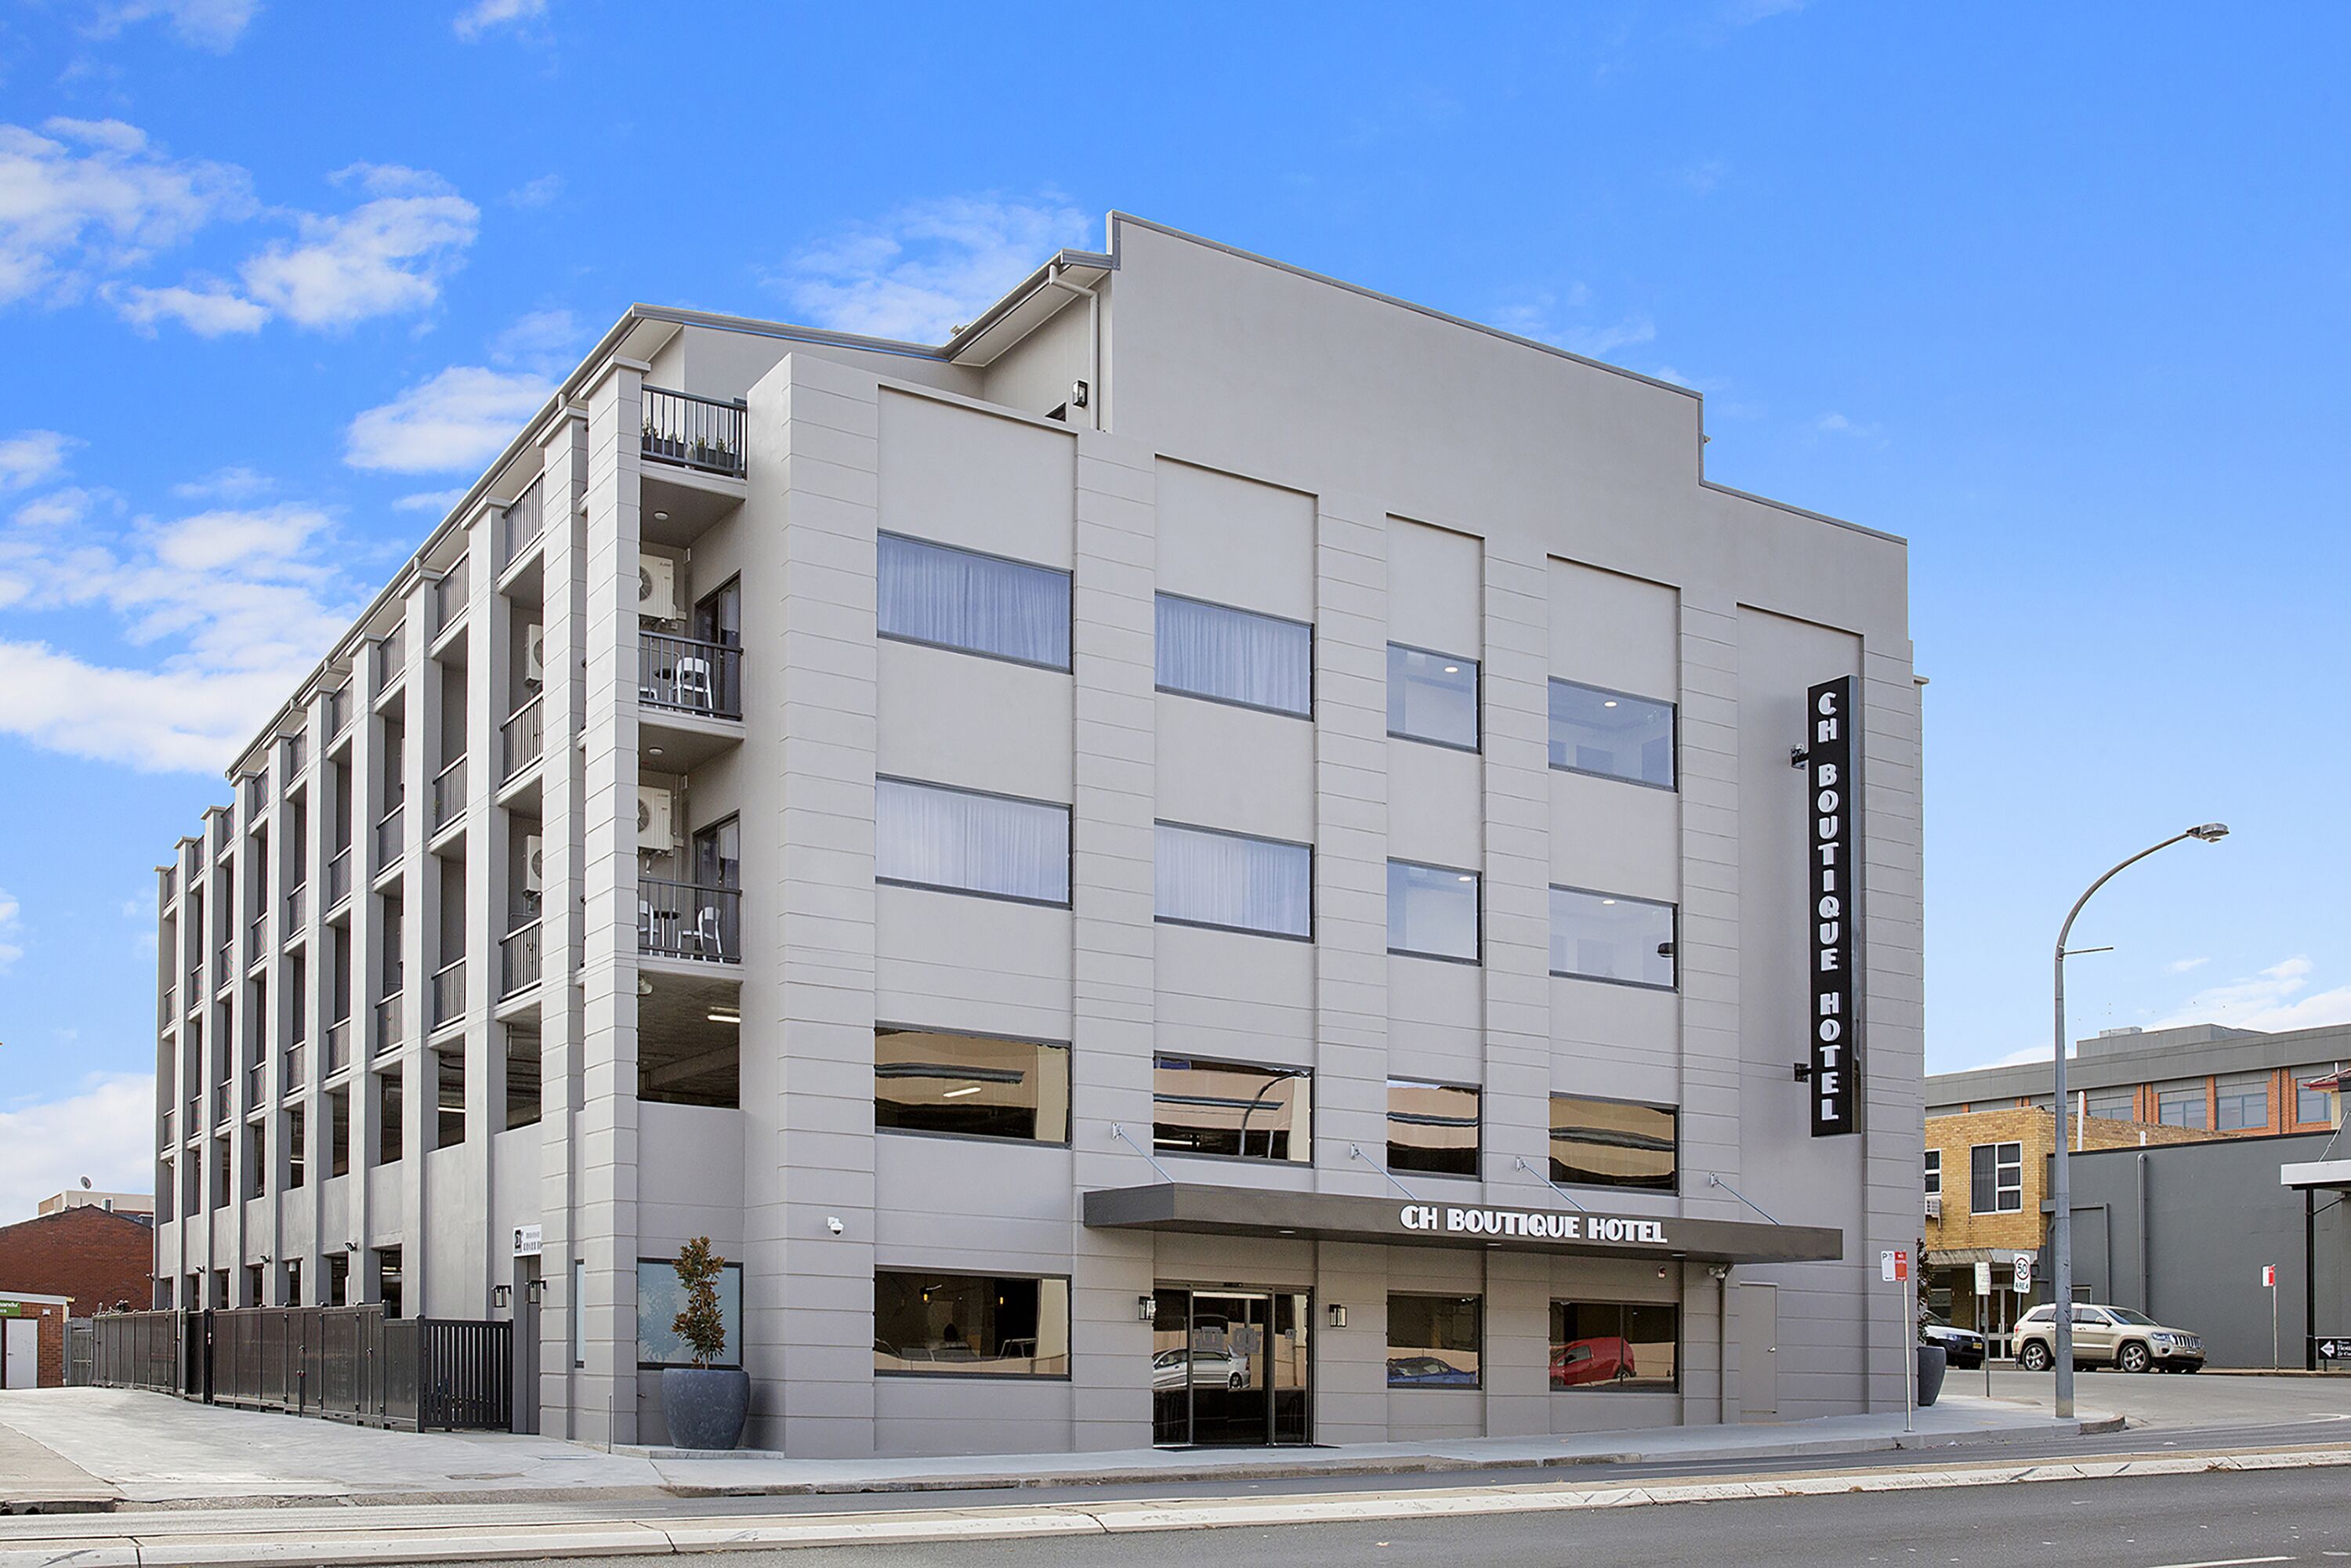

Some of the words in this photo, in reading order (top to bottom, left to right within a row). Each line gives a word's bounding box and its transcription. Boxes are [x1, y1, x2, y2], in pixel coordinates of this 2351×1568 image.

[1817, 692, 1838, 743] CH
[1817, 763, 1840, 972] BOUTIQUE
[1819, 991, 1841, 1121] HOTEL
[1400, 1204, 1438, 1230] CH
[1447, 1208, 1581, 1239] BOUTIQUE
[1588, 1217, 1668, 1244] HOTEL
[2015, 1281, 2029, 1290] AREA
[2017, 1263, 2028, 1275] 50
